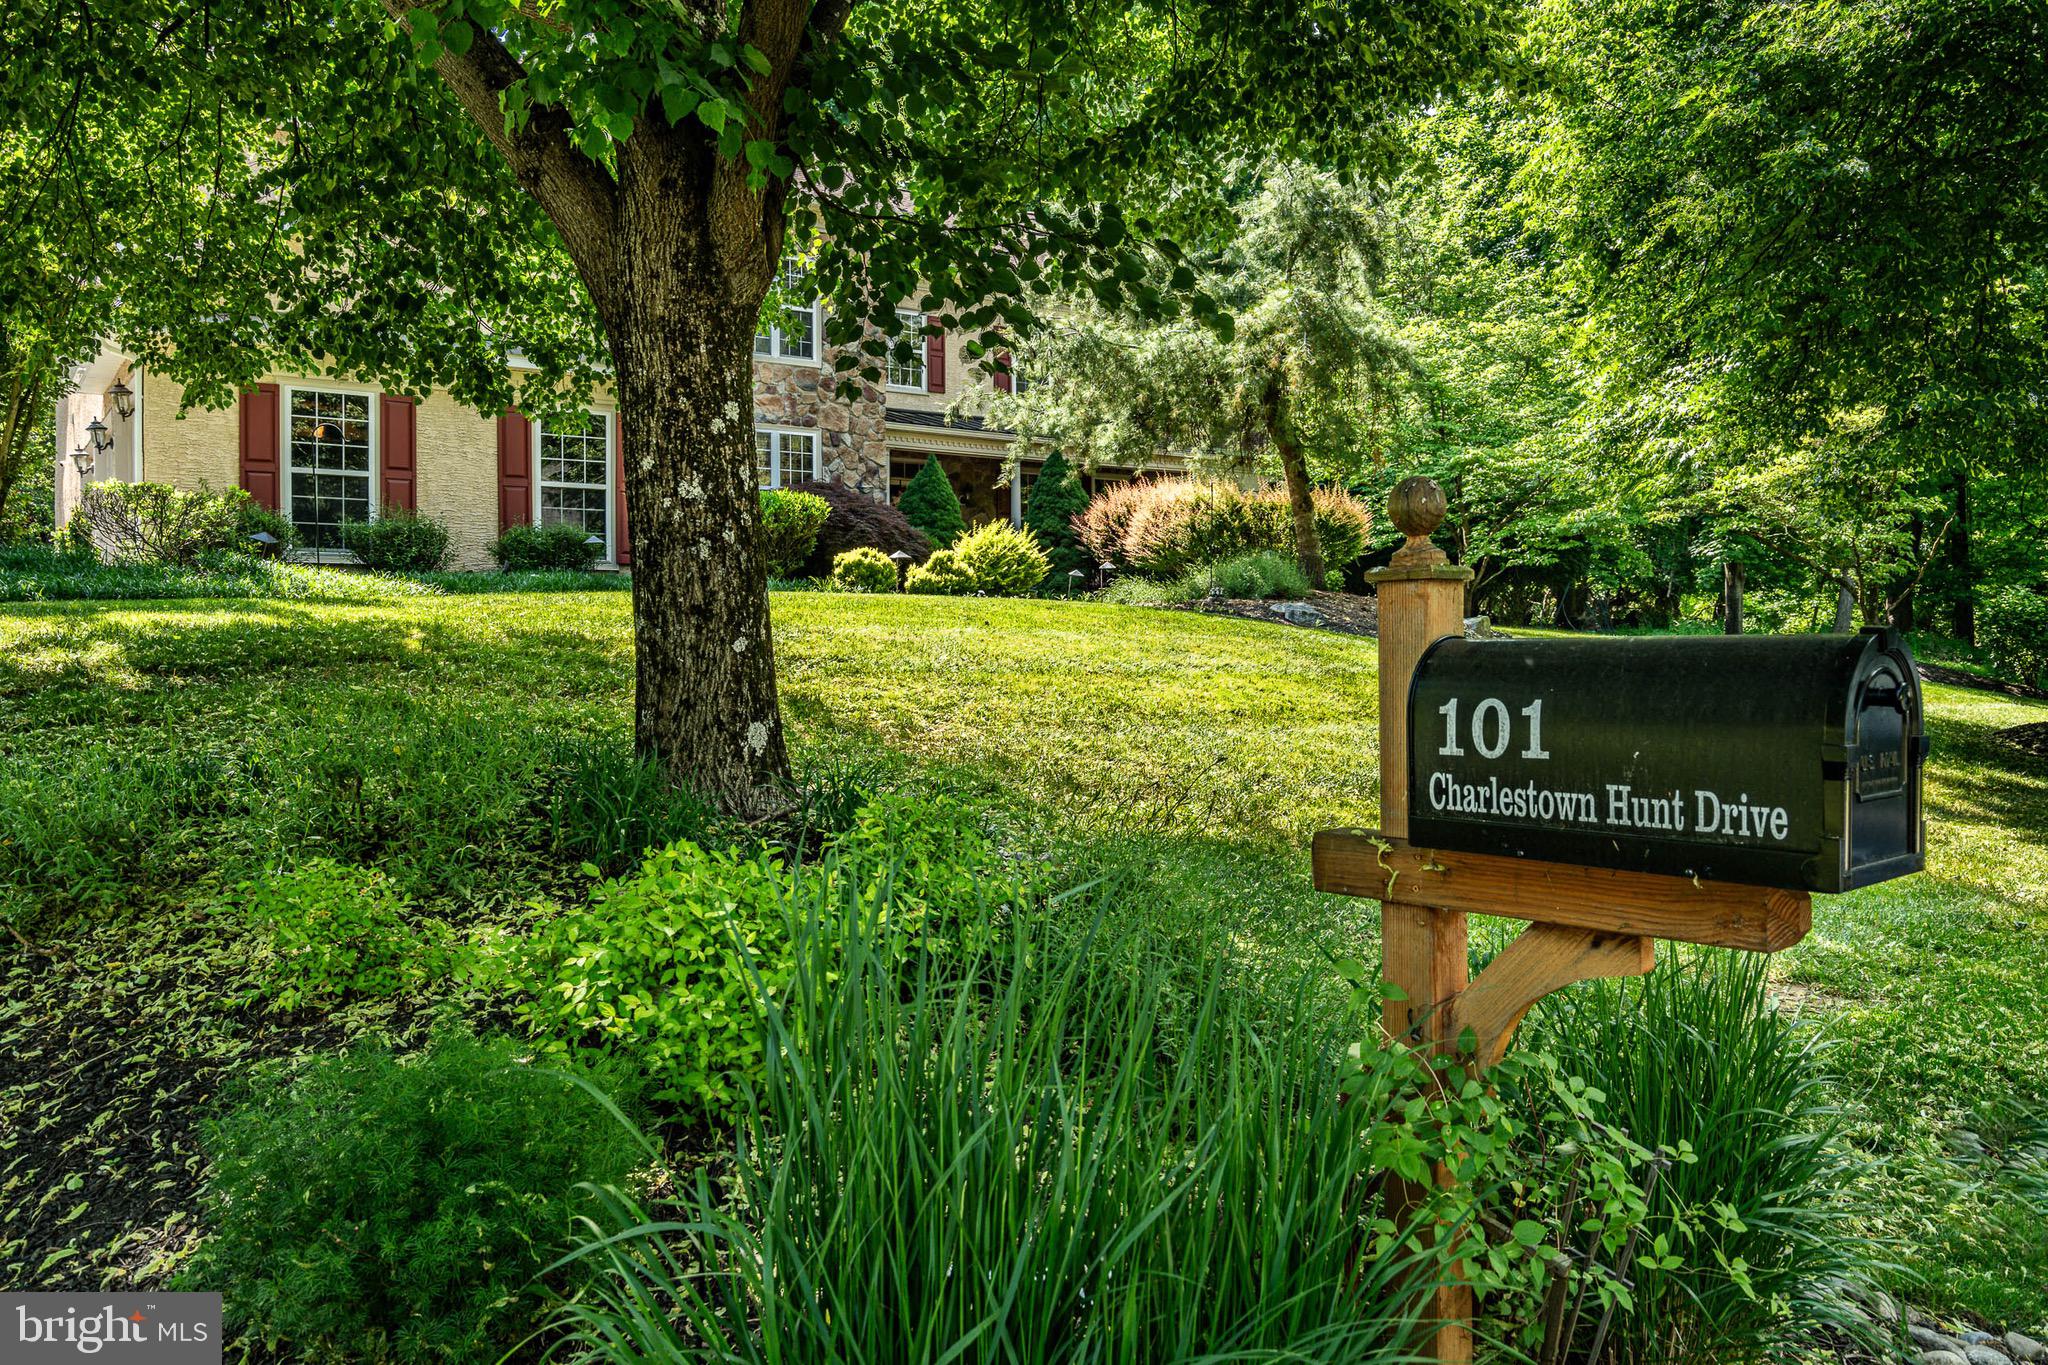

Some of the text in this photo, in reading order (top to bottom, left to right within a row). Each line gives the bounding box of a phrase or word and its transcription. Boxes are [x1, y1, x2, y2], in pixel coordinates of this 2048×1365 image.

[1438, 698, 1550, 759] 101
[1429, 772, 1789, 841] Charlestown Hunt Drive
